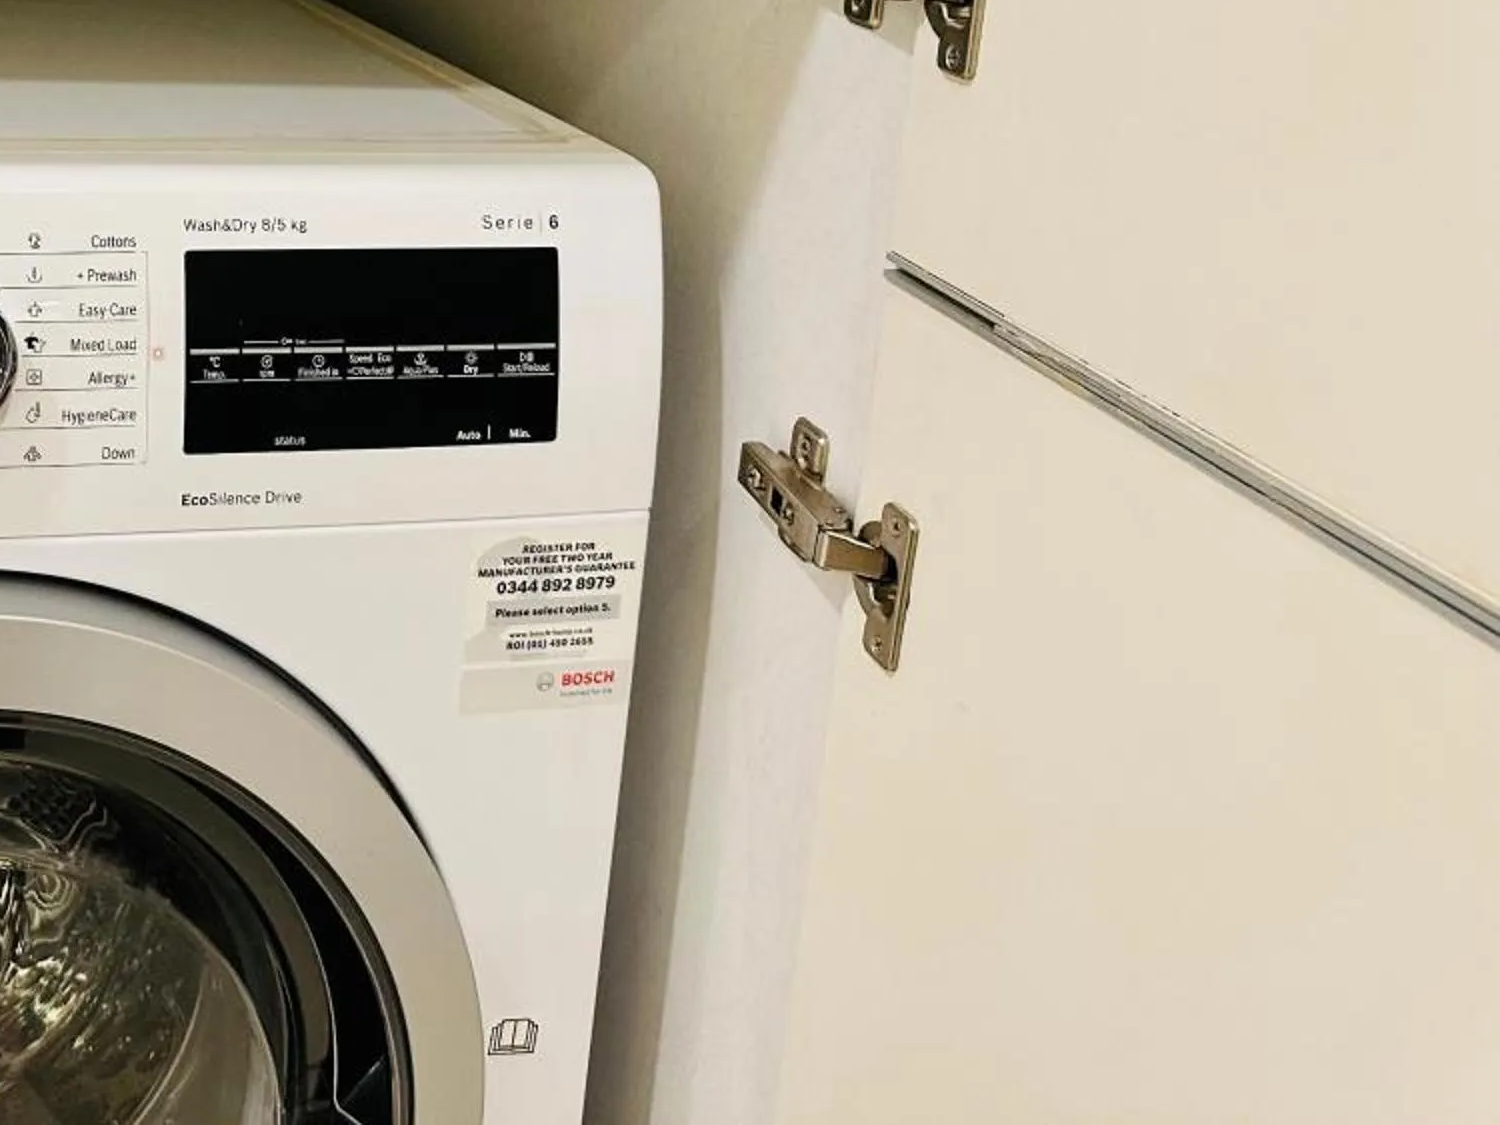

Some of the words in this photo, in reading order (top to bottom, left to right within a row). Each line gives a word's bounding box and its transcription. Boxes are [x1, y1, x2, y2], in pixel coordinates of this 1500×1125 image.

[183, 218, 257, 234] Wash&Dry
[261, 217, 287, 233] 8/5
[291, 219, 308, 234] kg
[482, 214, 534, 230] Serie
[548, 214, 560, 230] 6
[90, 234, 137, 248] Cottons
[87, 268, 137, 282] Prewash
[79, 303, 107, 319] Easy
[109, 302, 137, 316] Care
[70, 338, 106, 352] Mixed
[108, 338, 137, 352] Load
[463, 364, 479, 376] Dry
[61, 408, 137, 425] HygieneCare
[455, 429, 481, 441] Auto
[509, 427, 532, 439] Min.
[101, 446, 136, 460] Down
[181, 493, 261, 507] EcoSilence
[265, 491, 303, 505] Drive
[522, 544, 573, 554] REGISTER
[575, 542, 595, 551] FOR
[502, 555, 531, 566] YOUR
[533, 554, 559, 564] FREE
[561, 553, 585, 563] TWO
[587, 552, 613, 561] YEAR
[575, 561, 636, 573] GUARANTEE
[497, 579, 538, 594] 0344
[541, 578, 573, 593] 892
[575, 575, 615, 590] 8979
[495, 608, 530, 618] Please
[532, 606, 564, 616] select
[566, 603, 599, 615] option
[561, 671, 615, 686] BOSCH
